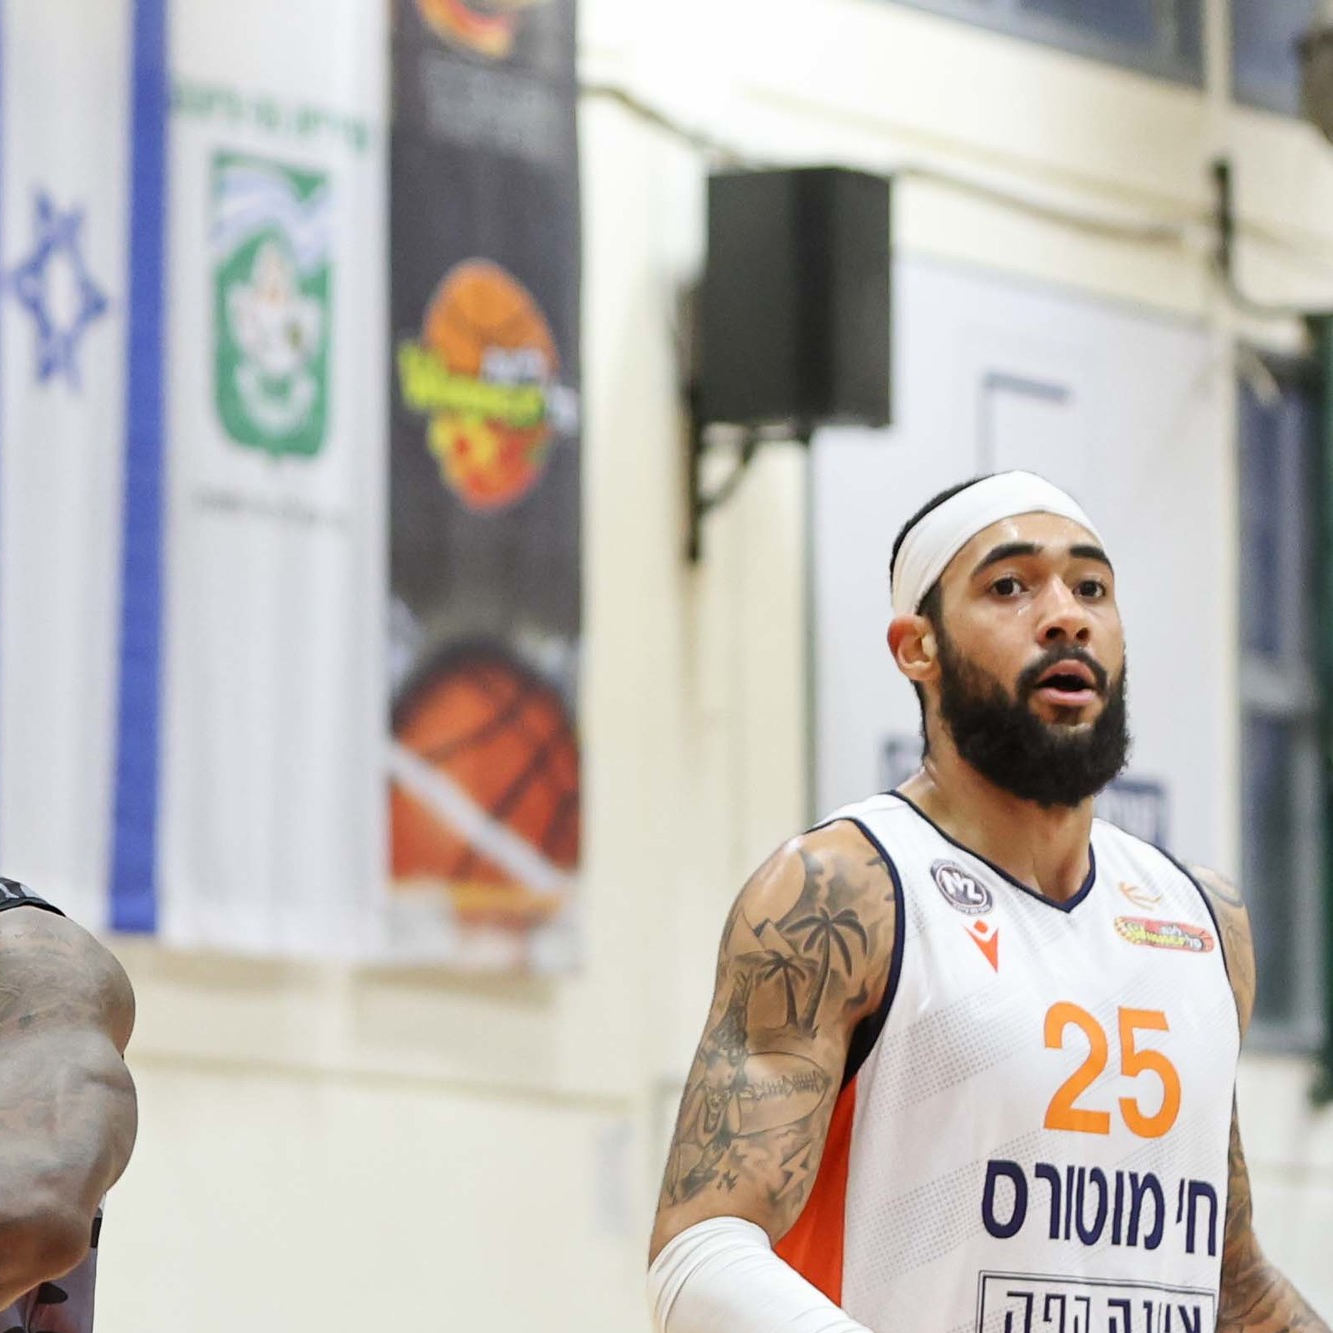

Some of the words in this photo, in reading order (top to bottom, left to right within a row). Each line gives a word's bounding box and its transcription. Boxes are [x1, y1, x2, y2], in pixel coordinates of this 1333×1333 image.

[1043, 1001, 1181, 1139] 25
[981, 1159, 1165, 1251] מוטורס
[1175, 1177, 1218, 1257] חי
